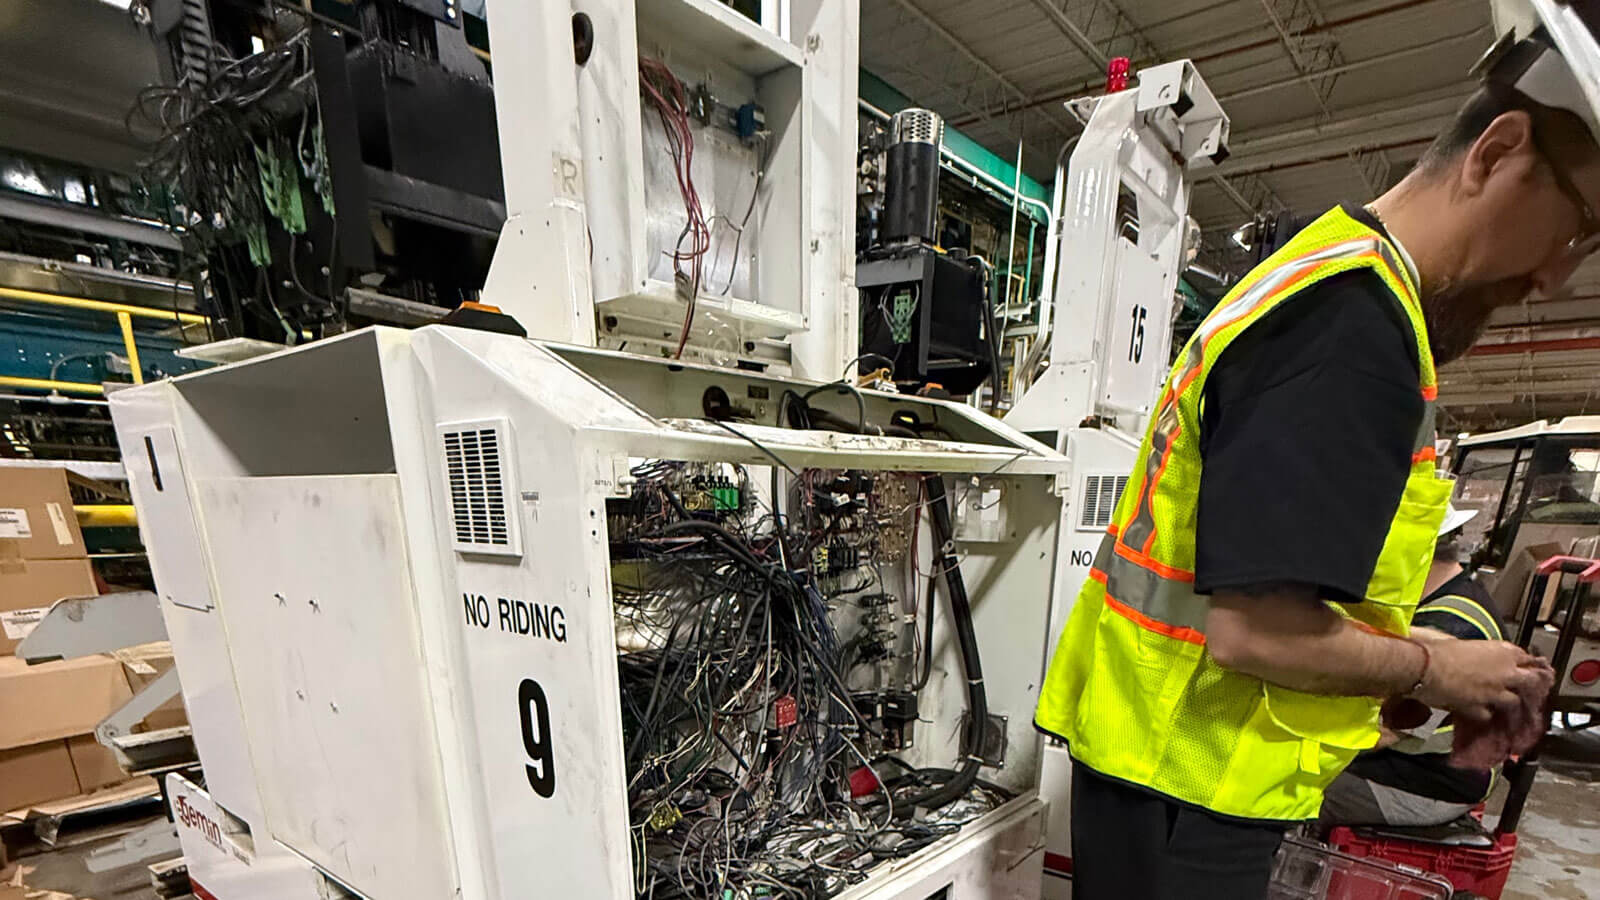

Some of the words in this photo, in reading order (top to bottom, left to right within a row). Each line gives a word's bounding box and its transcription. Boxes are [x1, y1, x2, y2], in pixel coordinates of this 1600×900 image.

[1128, 304, 1147, 365] 15
[1070, 550, 1093, 567] NO
[463, 593, 490, 629] NO
[497, 597, 568, 643] RIDING
[518, 678, 556, 799] 9
